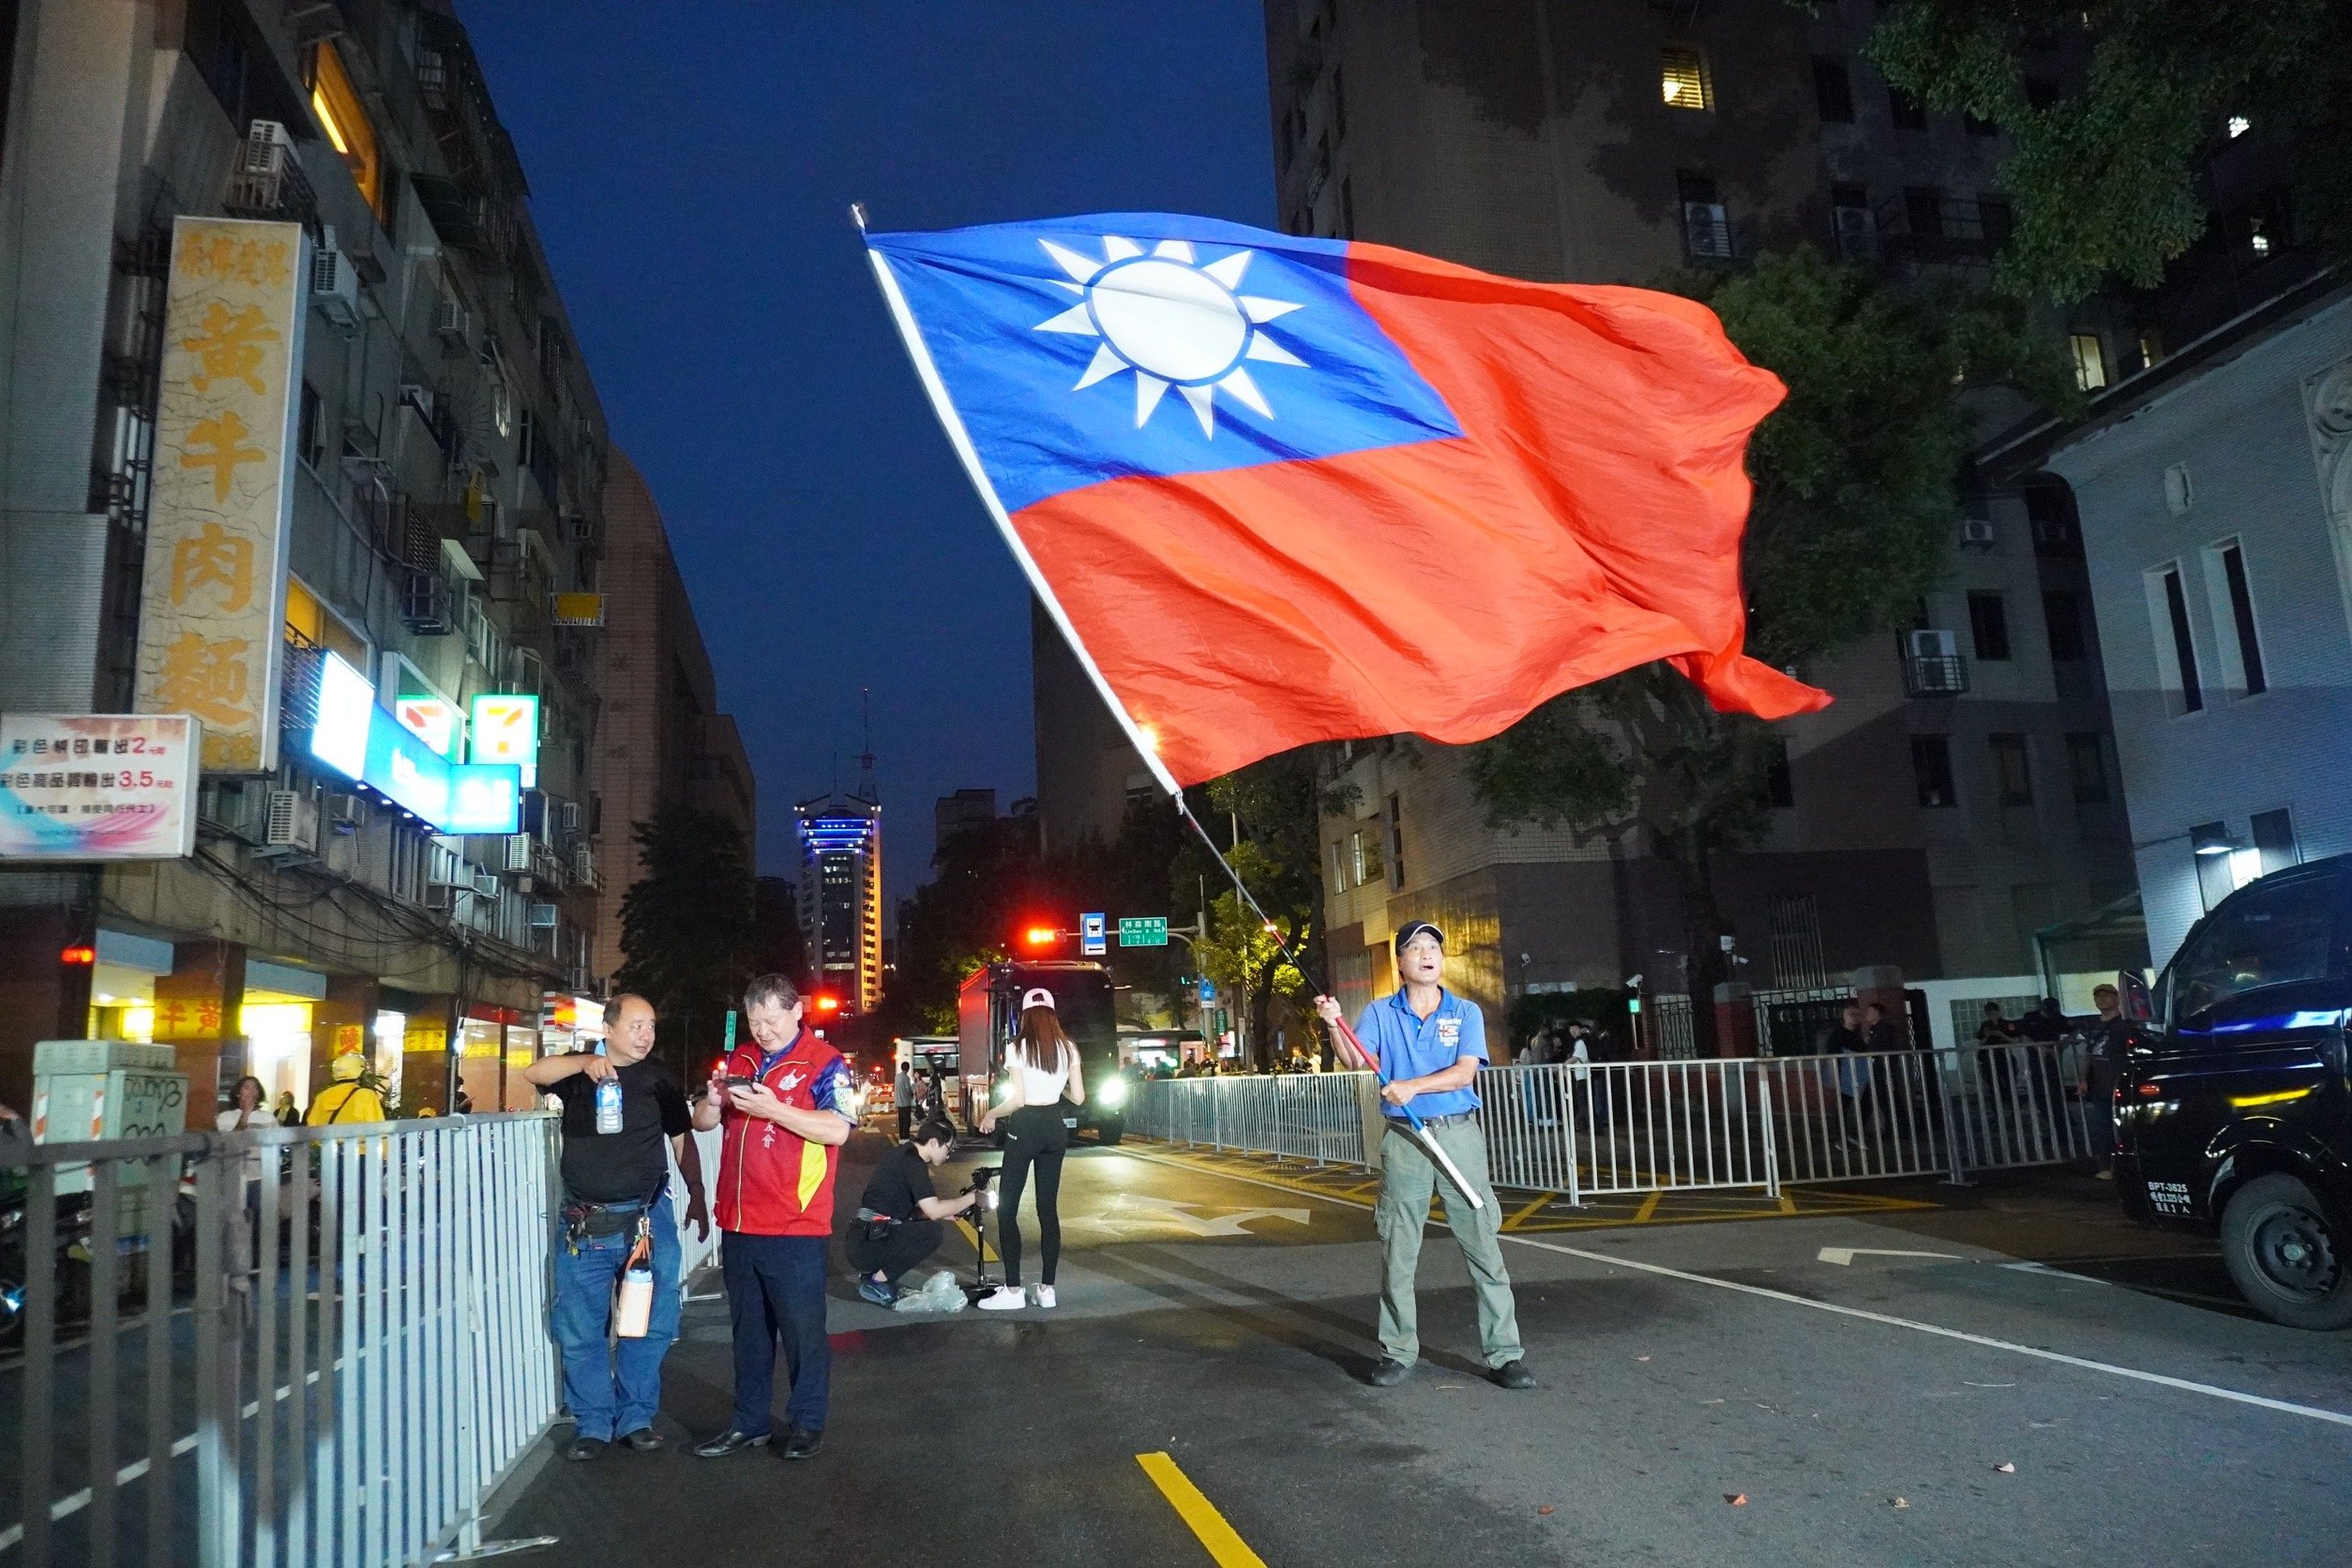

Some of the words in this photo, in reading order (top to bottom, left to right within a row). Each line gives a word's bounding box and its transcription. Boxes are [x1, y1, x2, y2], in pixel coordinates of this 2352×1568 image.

[153, 302, 281, 726] 黃牛肉麵
[1124, 919, 1162, 928] 林森南路
[2148, 1182, 2188, 1193] BPT-3625
